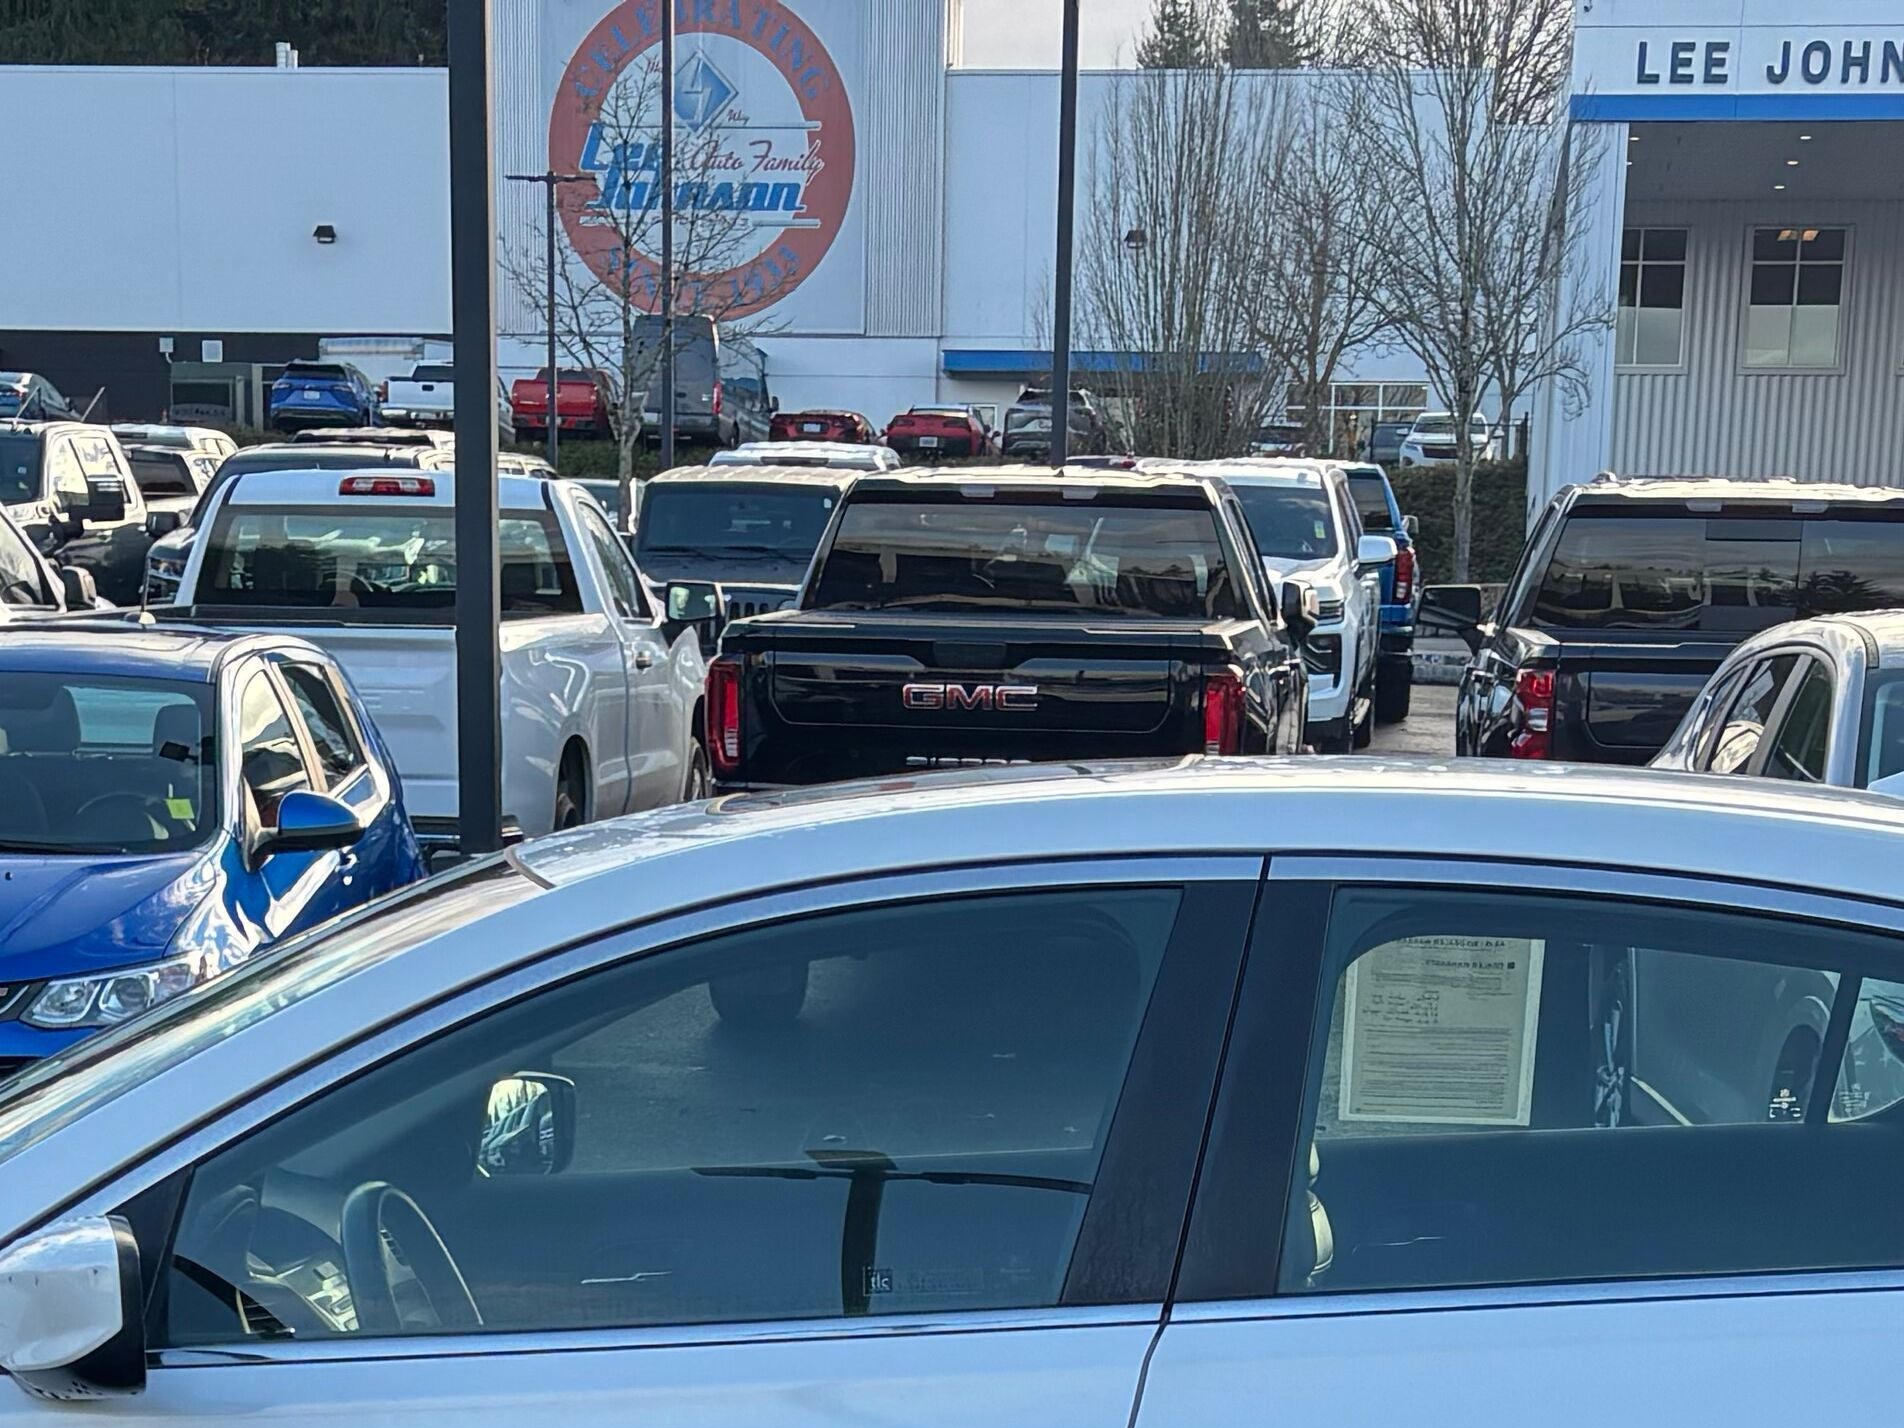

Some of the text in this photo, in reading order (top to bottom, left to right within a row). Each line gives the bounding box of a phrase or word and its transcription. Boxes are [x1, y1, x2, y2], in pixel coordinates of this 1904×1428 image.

[1637, 40, 1730, 85] LEE
[749, 139, 825, 185] Family
[902, 683, 1038, 712] GMC
